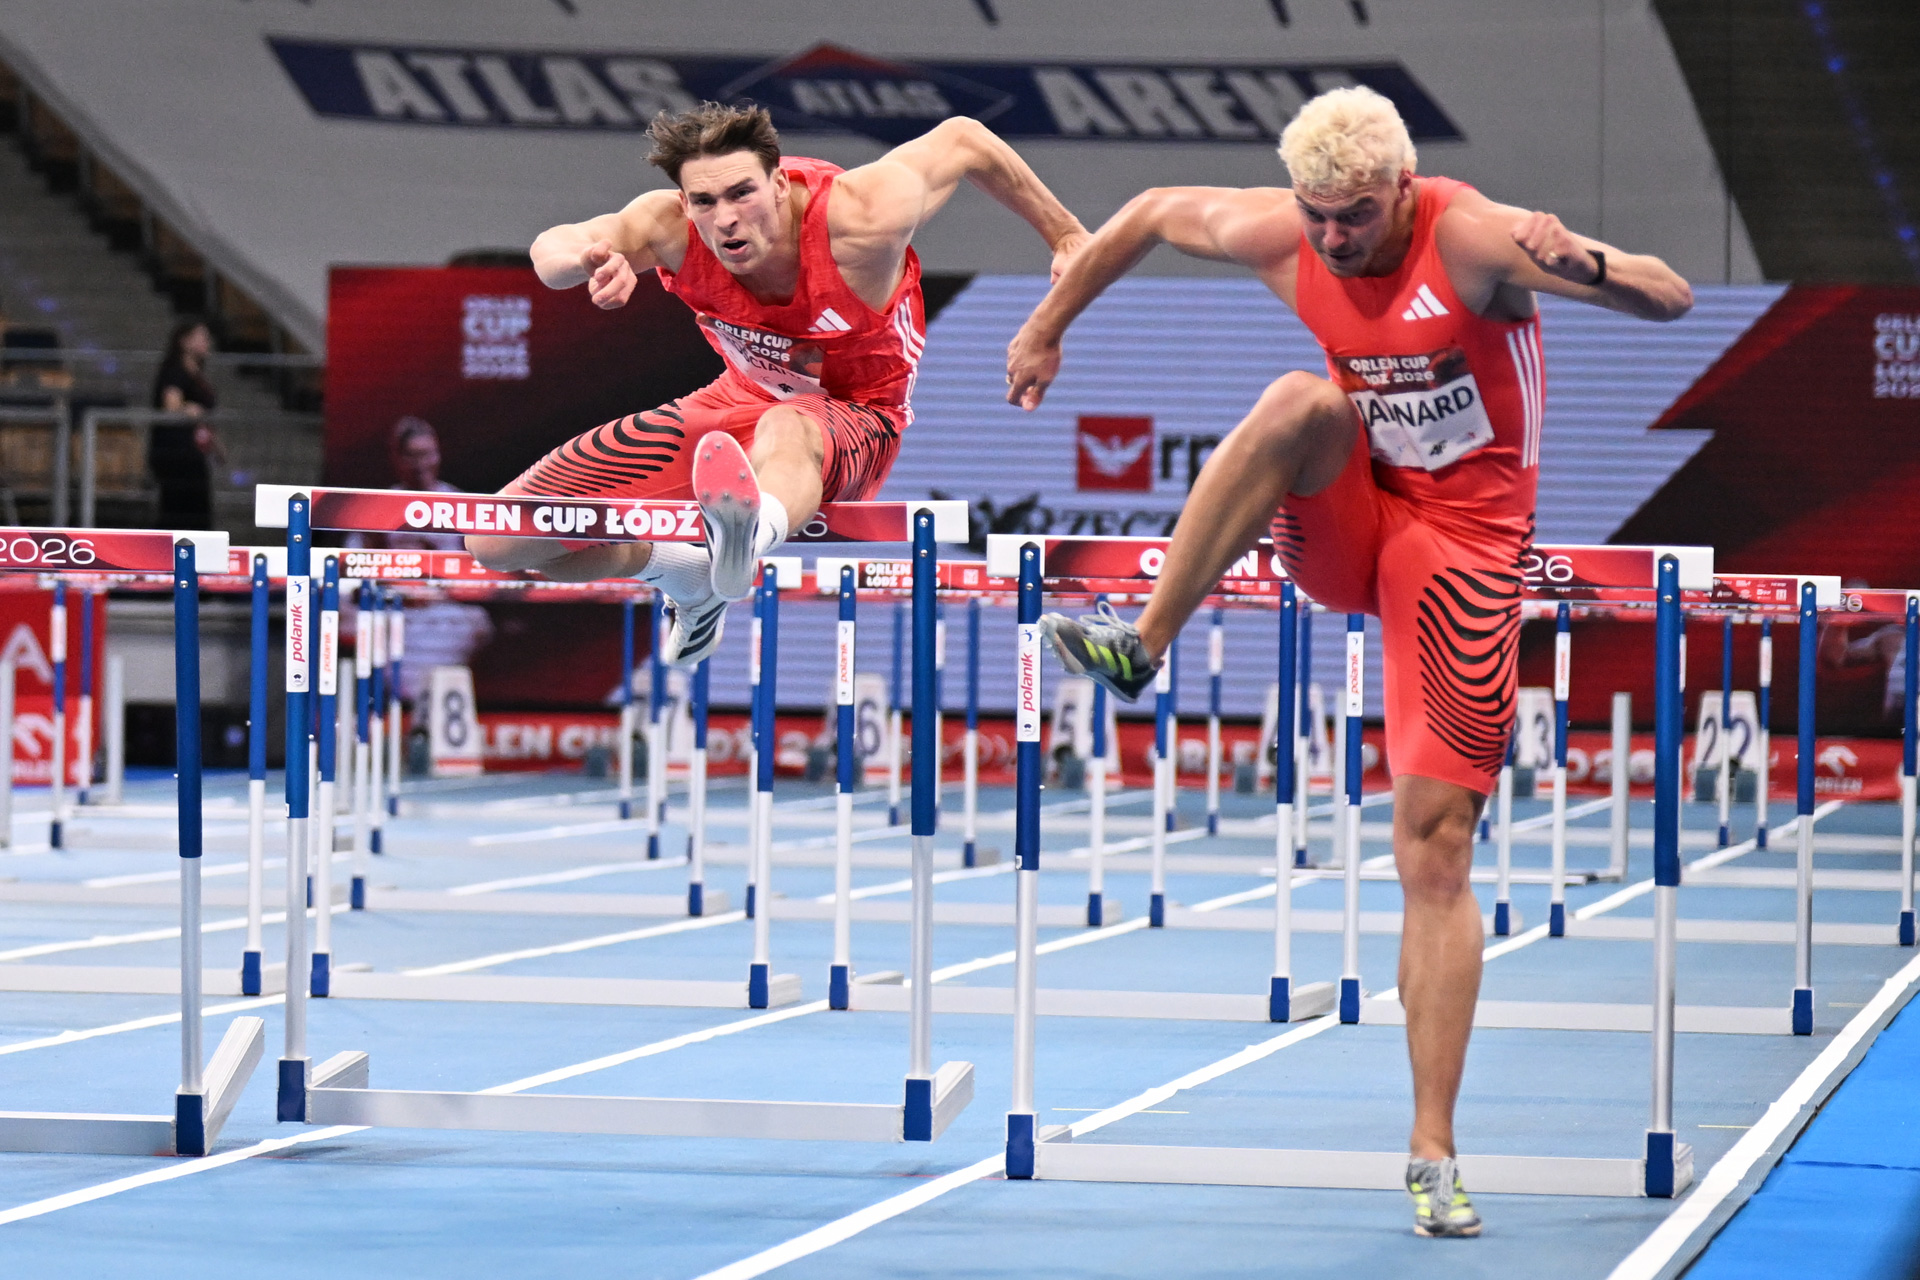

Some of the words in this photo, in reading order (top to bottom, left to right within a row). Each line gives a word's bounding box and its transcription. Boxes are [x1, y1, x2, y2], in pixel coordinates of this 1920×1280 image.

[351, 51, 704, 123] ATLAS
[791, 79, 952, 118] ATLAS
[714, 319, 760, 344] ORLEN
[763, 334, 793, 350] CUP
[1875, 333, 1919, 360] CU
[751, 345, 791, 363] 2026
[1350, 357, 1400, 372] ORLEN
[1401, 355, 1430, 369] CUP
[1393, 370, 1435, 383] 2026
[405, 501, 521, 531] ORLEN
[533, 506, 598, 533] CUP
[604, 503, 701, 537] ŁÓDŹ
[345, 554, 392, 567] ORLEN
[395, 554, 422, 566] CUP
[382, 566, 422, 578] 2026
[865, 563, 911, 576] ORLEN
[290, 603, 306, 663] polanik
[840, 642, 848, 683] polanik
[1351, 653, 1359, 694] polanik
[1018, 652, 1036, 712] polanik
[443, 691, 467, 748] 8
[857, 699, 881, 757] 6
[1535, 712, 1550, 769] 3
